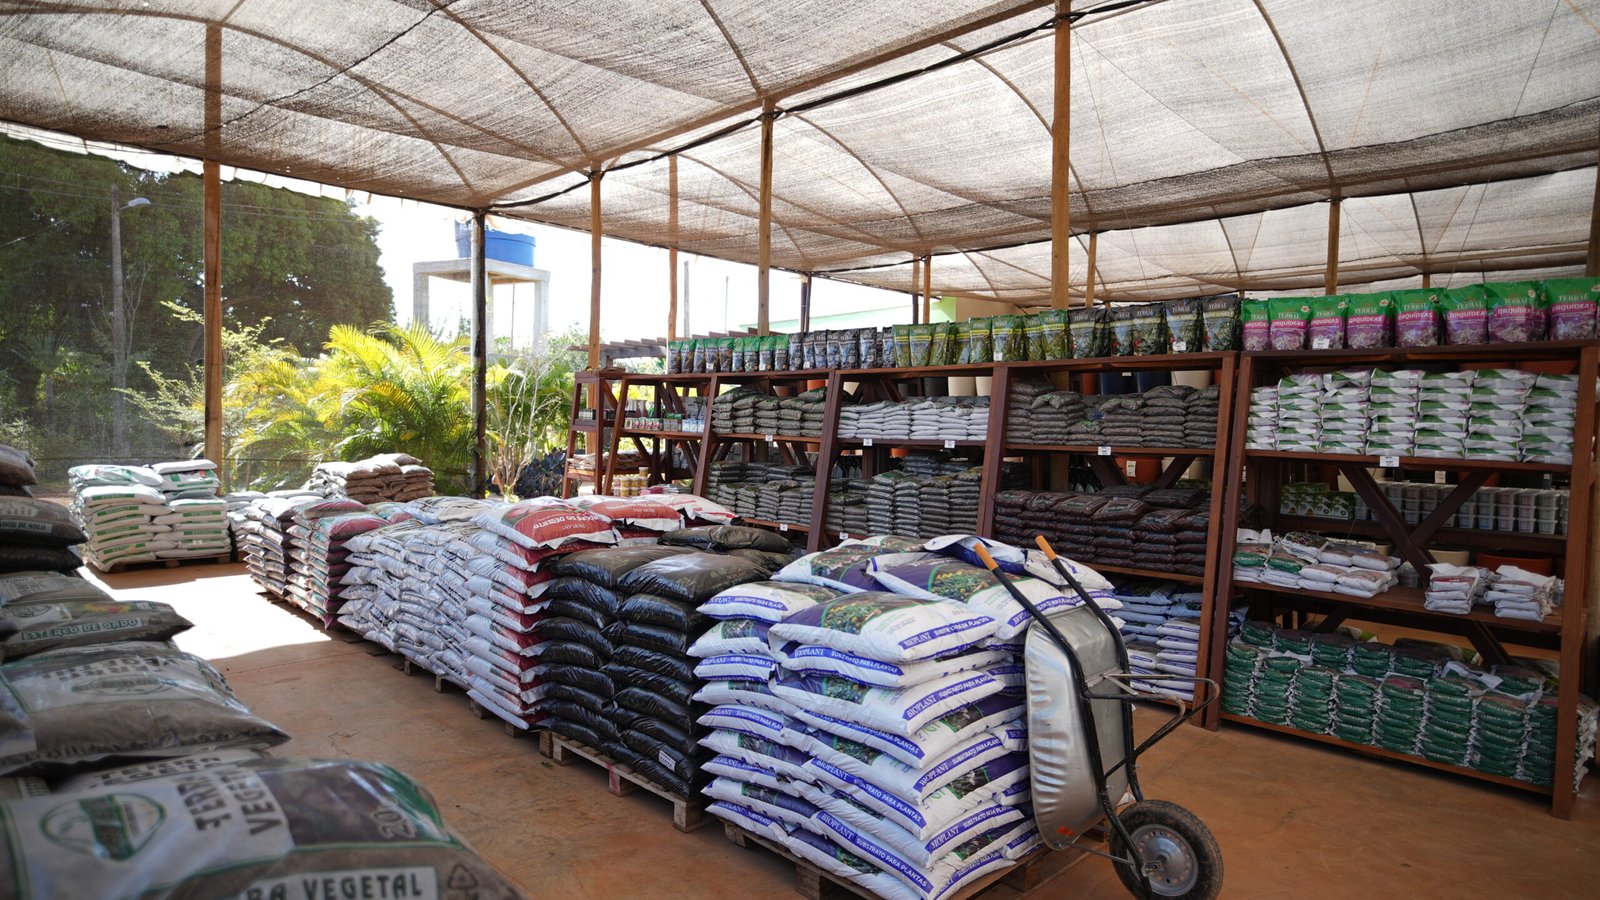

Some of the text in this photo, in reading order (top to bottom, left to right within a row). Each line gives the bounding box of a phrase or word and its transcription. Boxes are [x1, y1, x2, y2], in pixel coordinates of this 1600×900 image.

[907, 696, 936, 718] BIOPLANT
[894, 735, 920, 754] PLANTAS
[919, 763, 948, 786] BIOPLANT
[816, 758, 848, 781] BIOPLANT
[882, 794, 896, 806] PARA
[896, 803, 922, 822] PLANTAS
[821, 813, 928, 888] BIOPLANT SUBSTRATO PARA PLANTAS
[302, 873, 423, 900] VEGETAL
